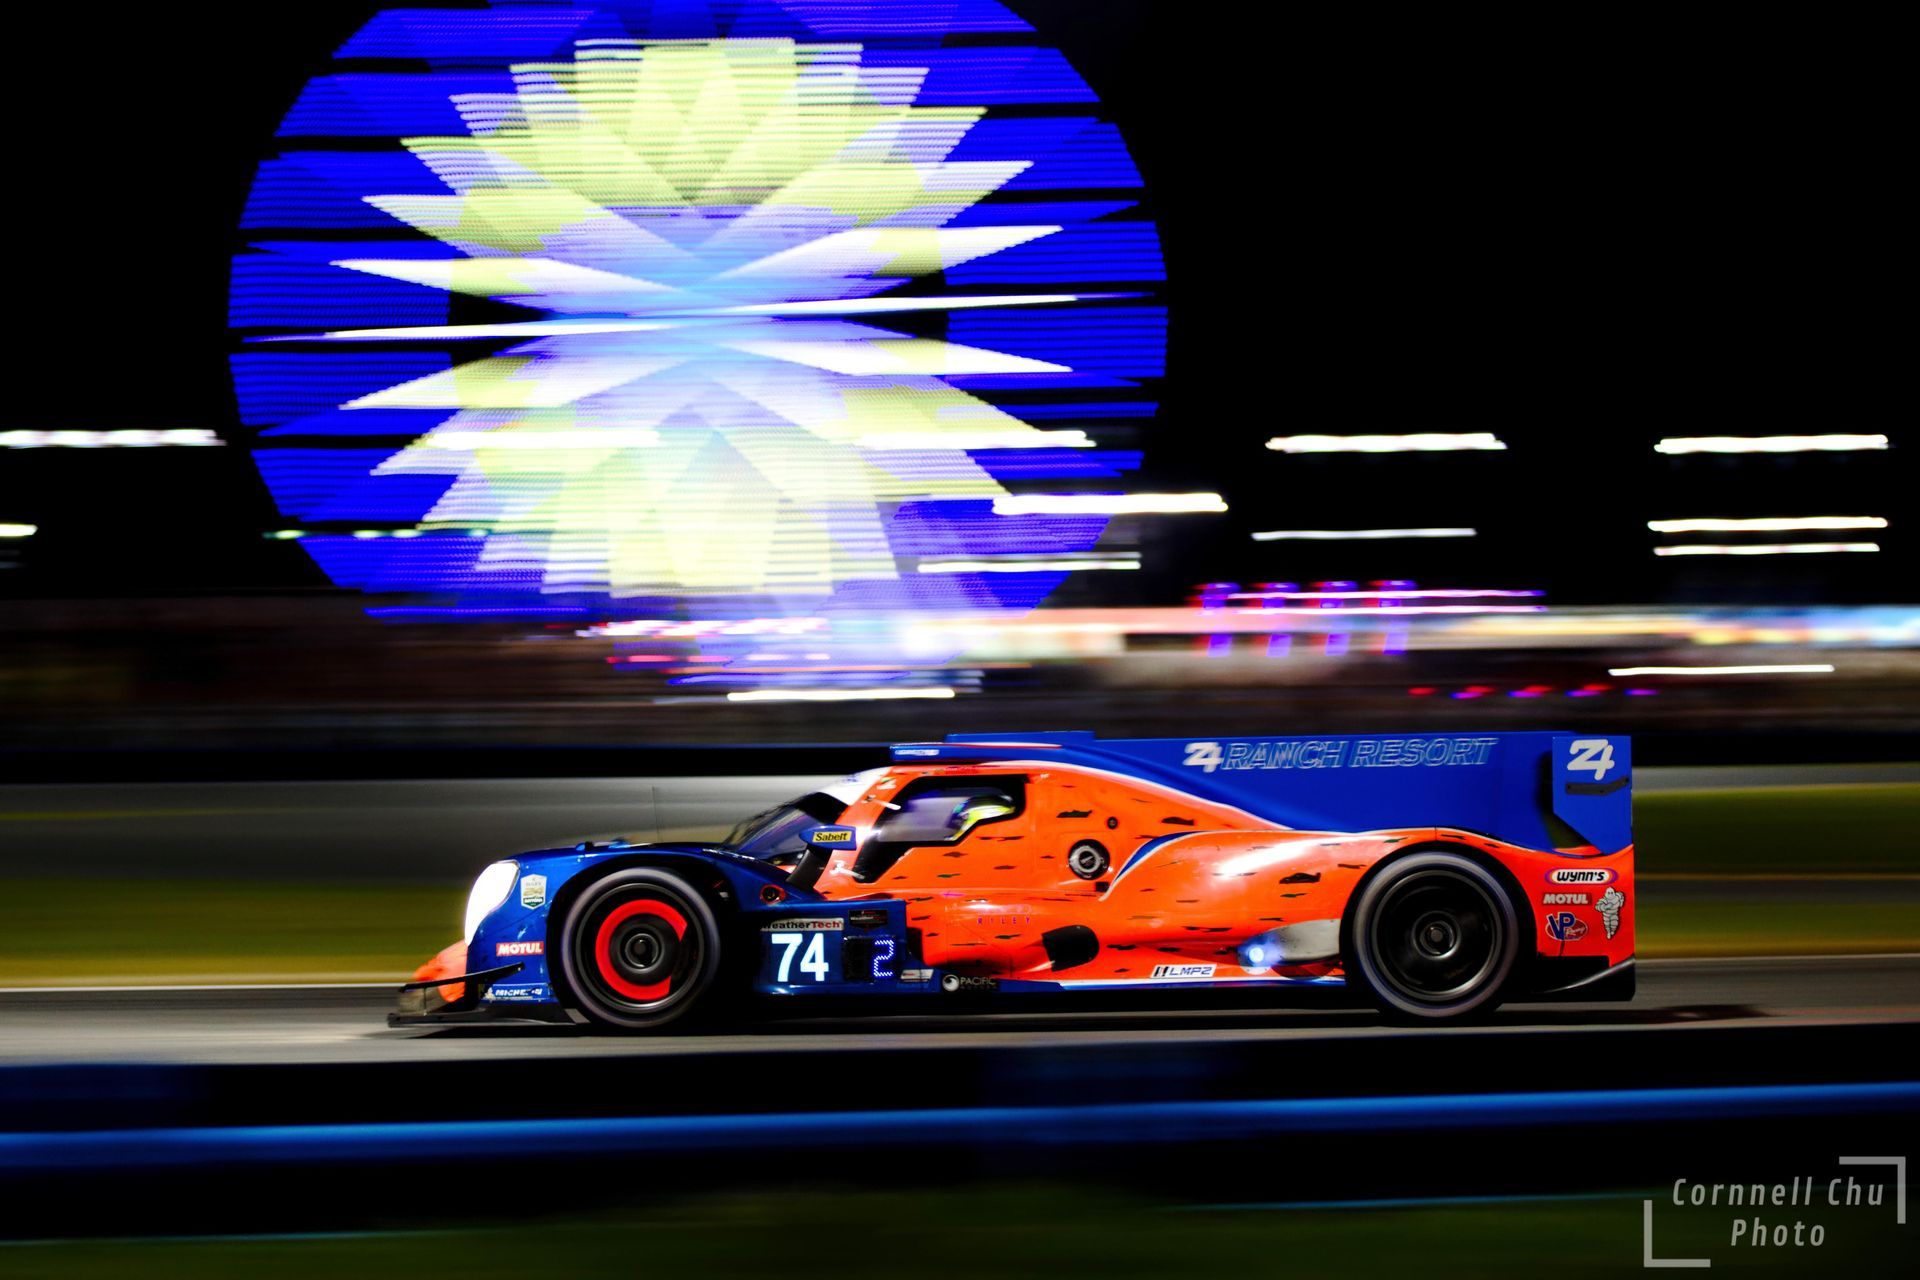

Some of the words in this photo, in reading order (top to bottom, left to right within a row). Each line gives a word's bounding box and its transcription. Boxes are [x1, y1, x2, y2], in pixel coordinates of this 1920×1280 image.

[1221, 741, 1348, 770] RANCH
[1349, 738, 1499, 768] RESORT
[1567, 739, 1615, 781] 24
[815, 832, 849, 841] Sabelt
[1543, 893, 1589, 905] MOTUL
[977, 916, 1030, 925] RILEY
[1546, 912, 1576, 941] VP
[498, 943, 542, 955] MOTUL
[771, 932, 829, 982] 74
[873, 938, 895, 977] 2
[1169, 966, 1213, 976] LMP2
[960, 976, 997, 985] PACIFIC
